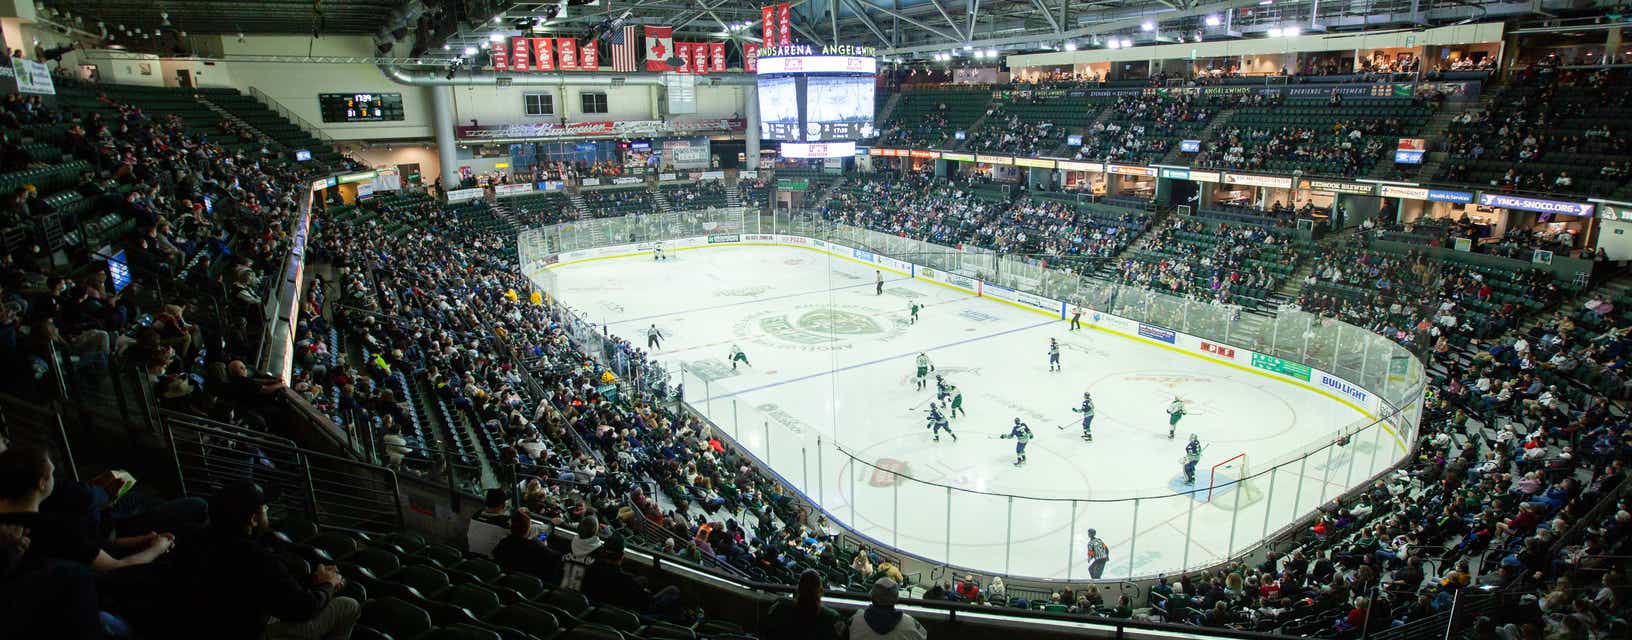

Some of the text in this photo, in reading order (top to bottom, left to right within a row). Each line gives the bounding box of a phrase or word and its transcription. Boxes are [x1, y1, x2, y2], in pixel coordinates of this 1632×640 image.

[777, 45, 812, 56] ARENA
[822, 44, 855, 55] ANGEL
[1322, 376, 1367, 401] BUD LIGHT
